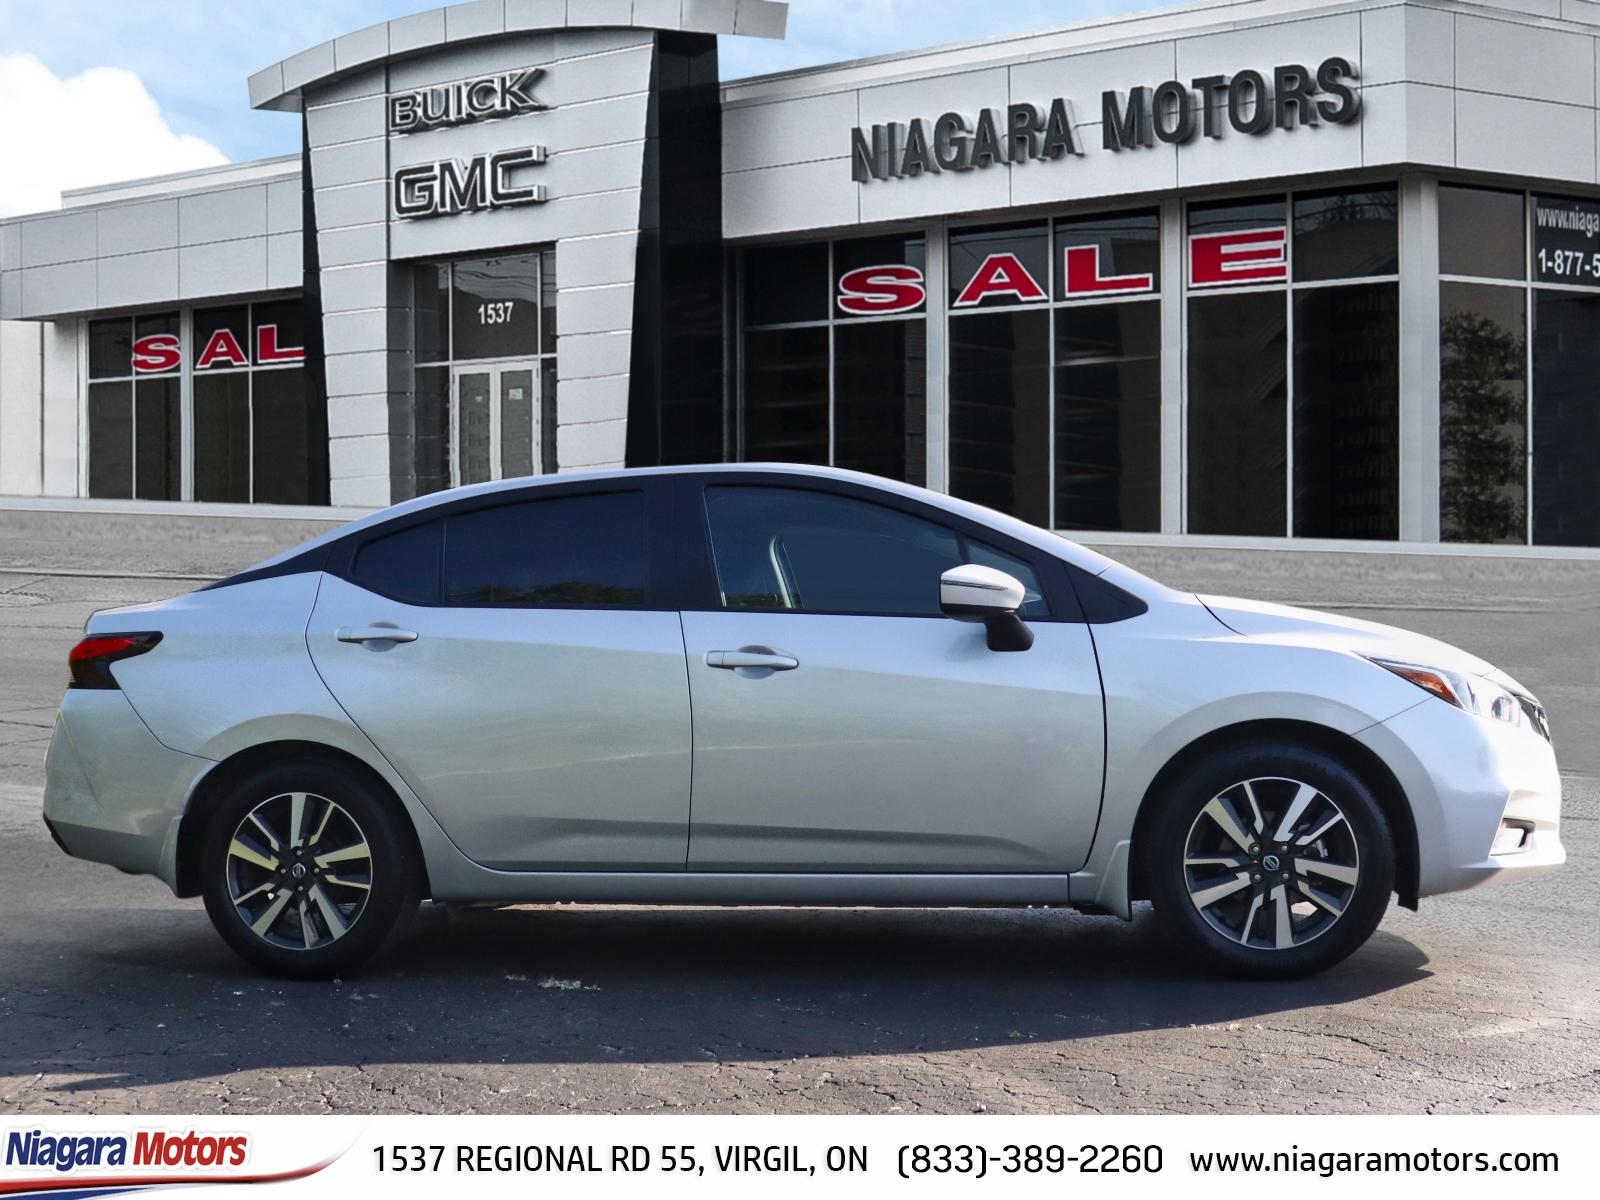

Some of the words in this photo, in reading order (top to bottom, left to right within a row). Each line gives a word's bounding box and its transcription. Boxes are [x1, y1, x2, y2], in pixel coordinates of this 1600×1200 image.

[389, 68, 547, 131] BUICK
[851, 98, 1085, 183] NIAGARA
[1102, 57, 1363, 152] MOTORS
[394, 145, 547, 218] GMC
[837, 225, 1288, 316] SALE
[478, 301, 514, 325] 1537
